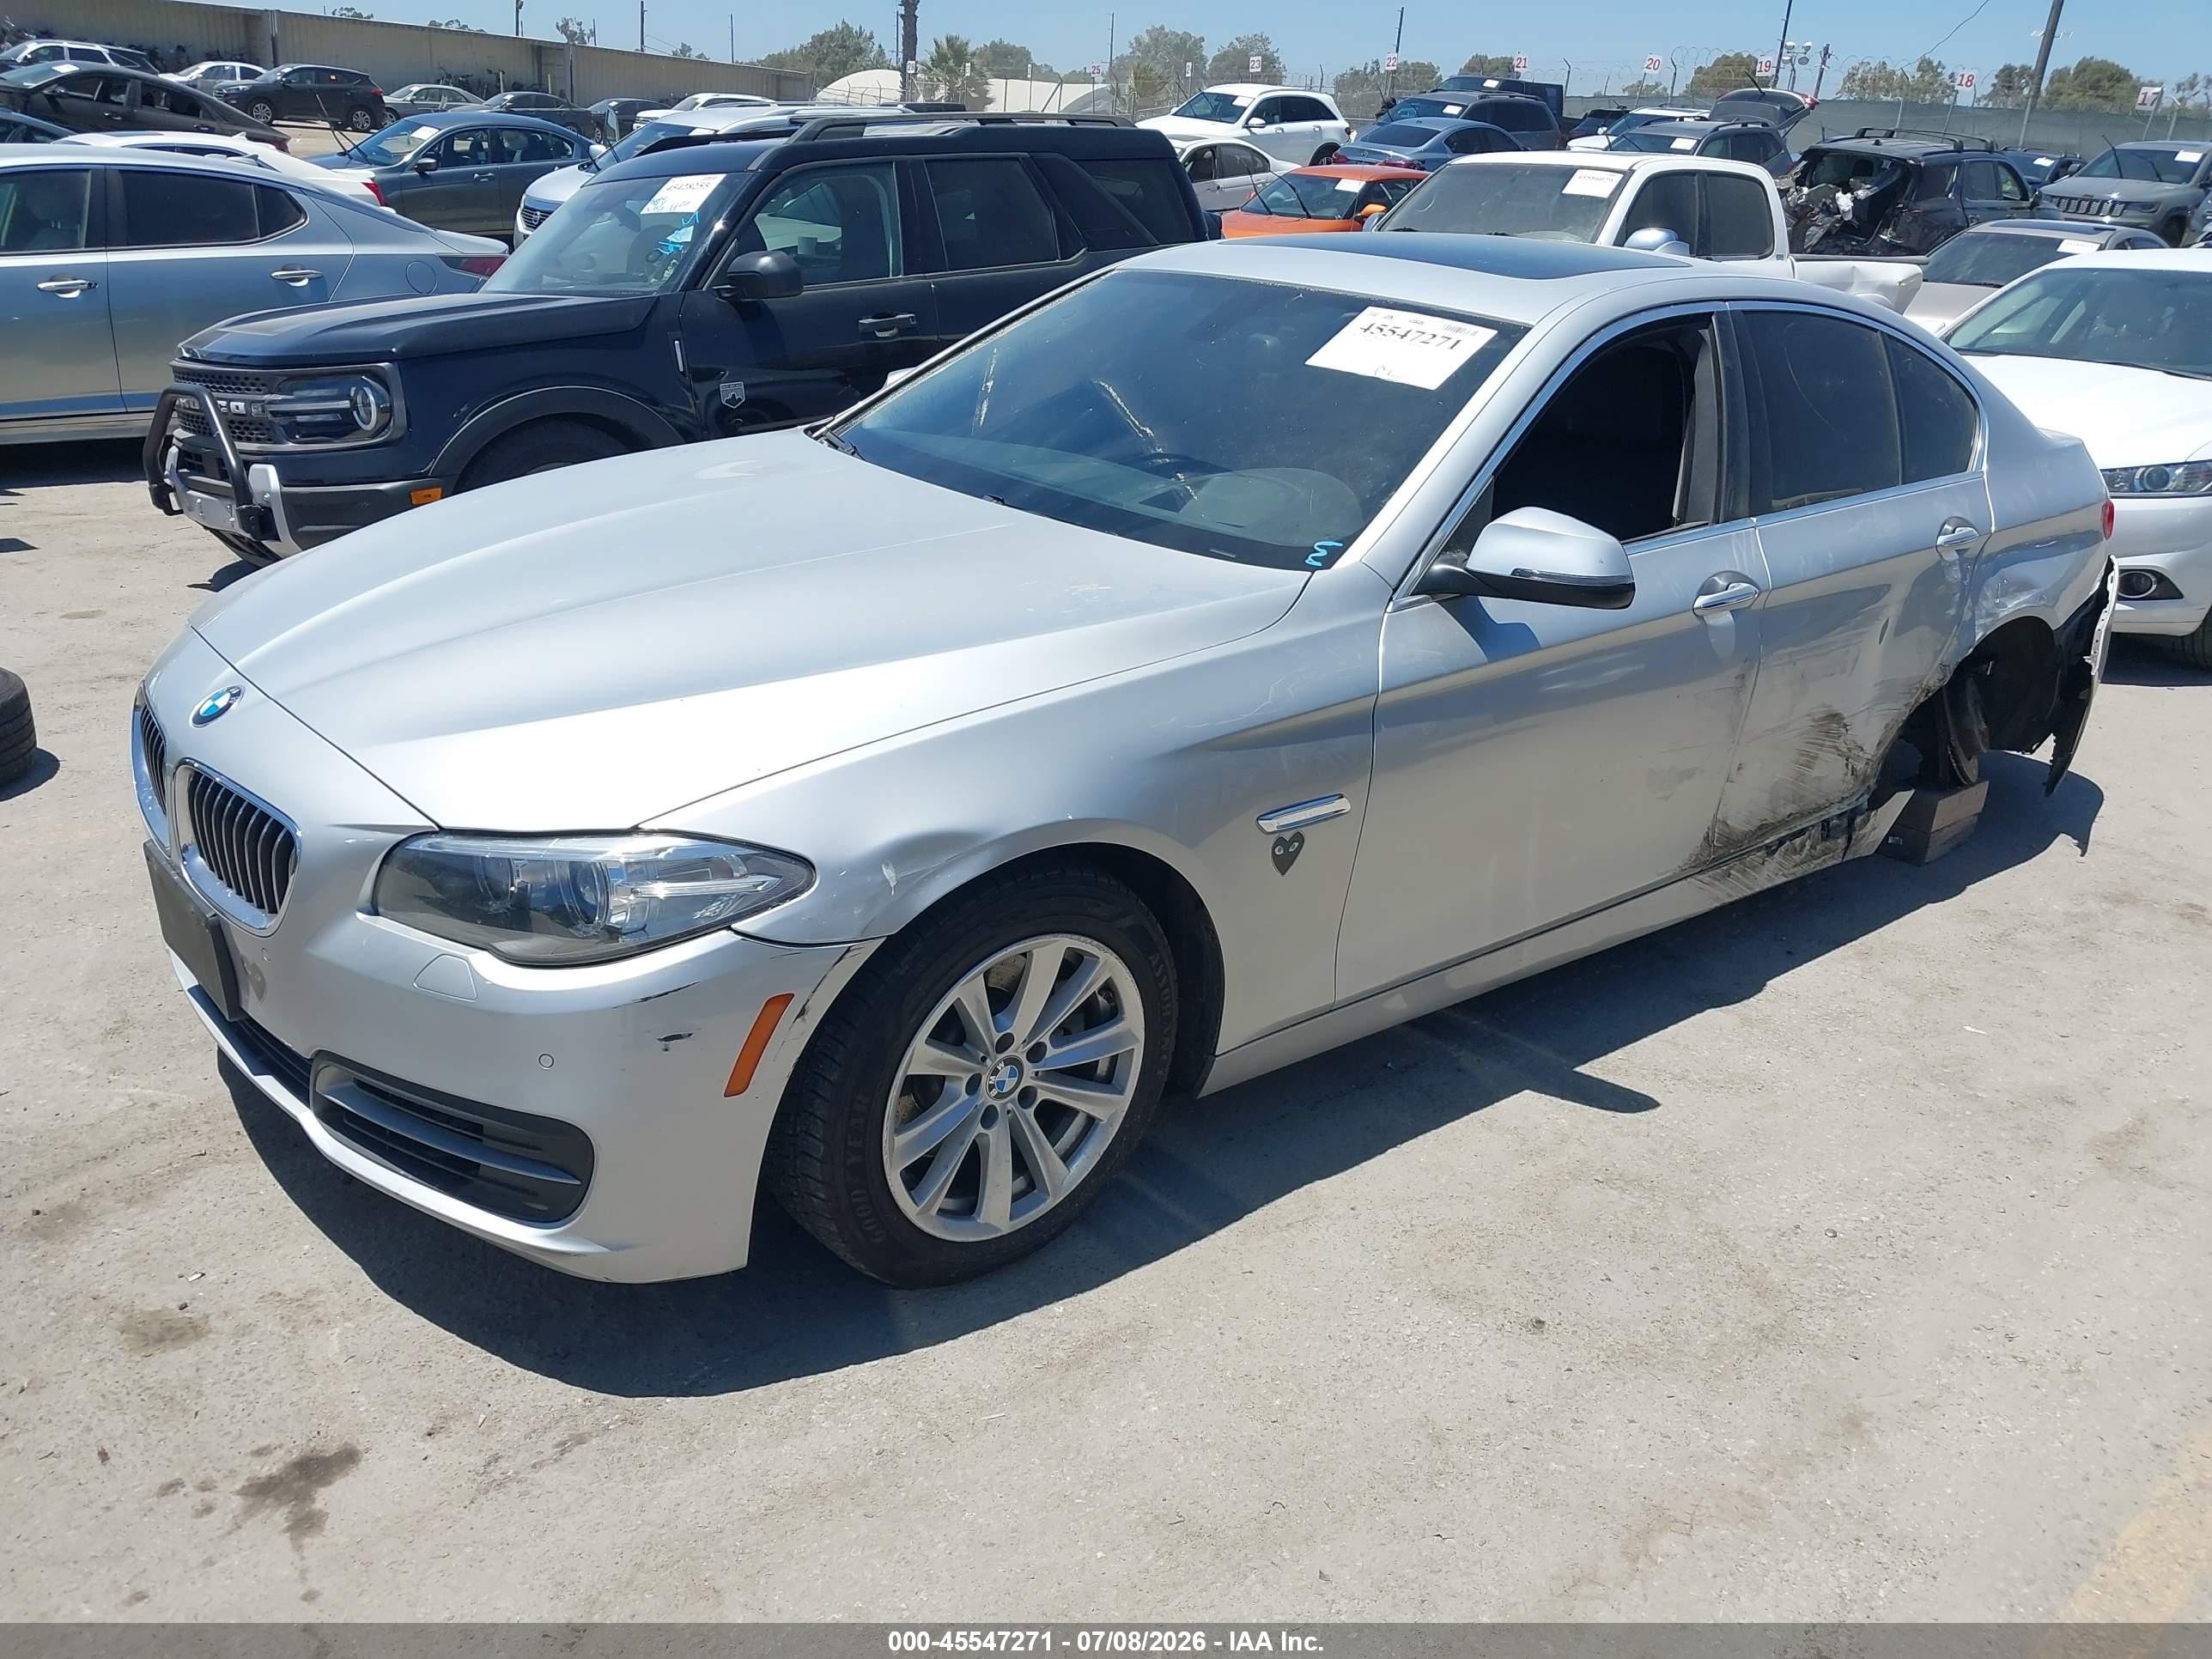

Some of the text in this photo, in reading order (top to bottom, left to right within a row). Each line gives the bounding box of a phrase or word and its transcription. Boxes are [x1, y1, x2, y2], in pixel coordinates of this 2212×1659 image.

[1250, 58, 1261, 70] 23
[1386, 57, 1397, 67] 22
[1516, 57, 1528, 69] 21
[1645, 58, 1661, 70] 20
[1757, 60, 1771, 72] 19
[1092, 65, 1100, 75] 25
[1957, 73, 1975, 88] 18
[2137, 92, 2160, 106] 17
[1359, 322, 1462, 350] 45547271
[988, 1060, 1006, 1097] BMW
